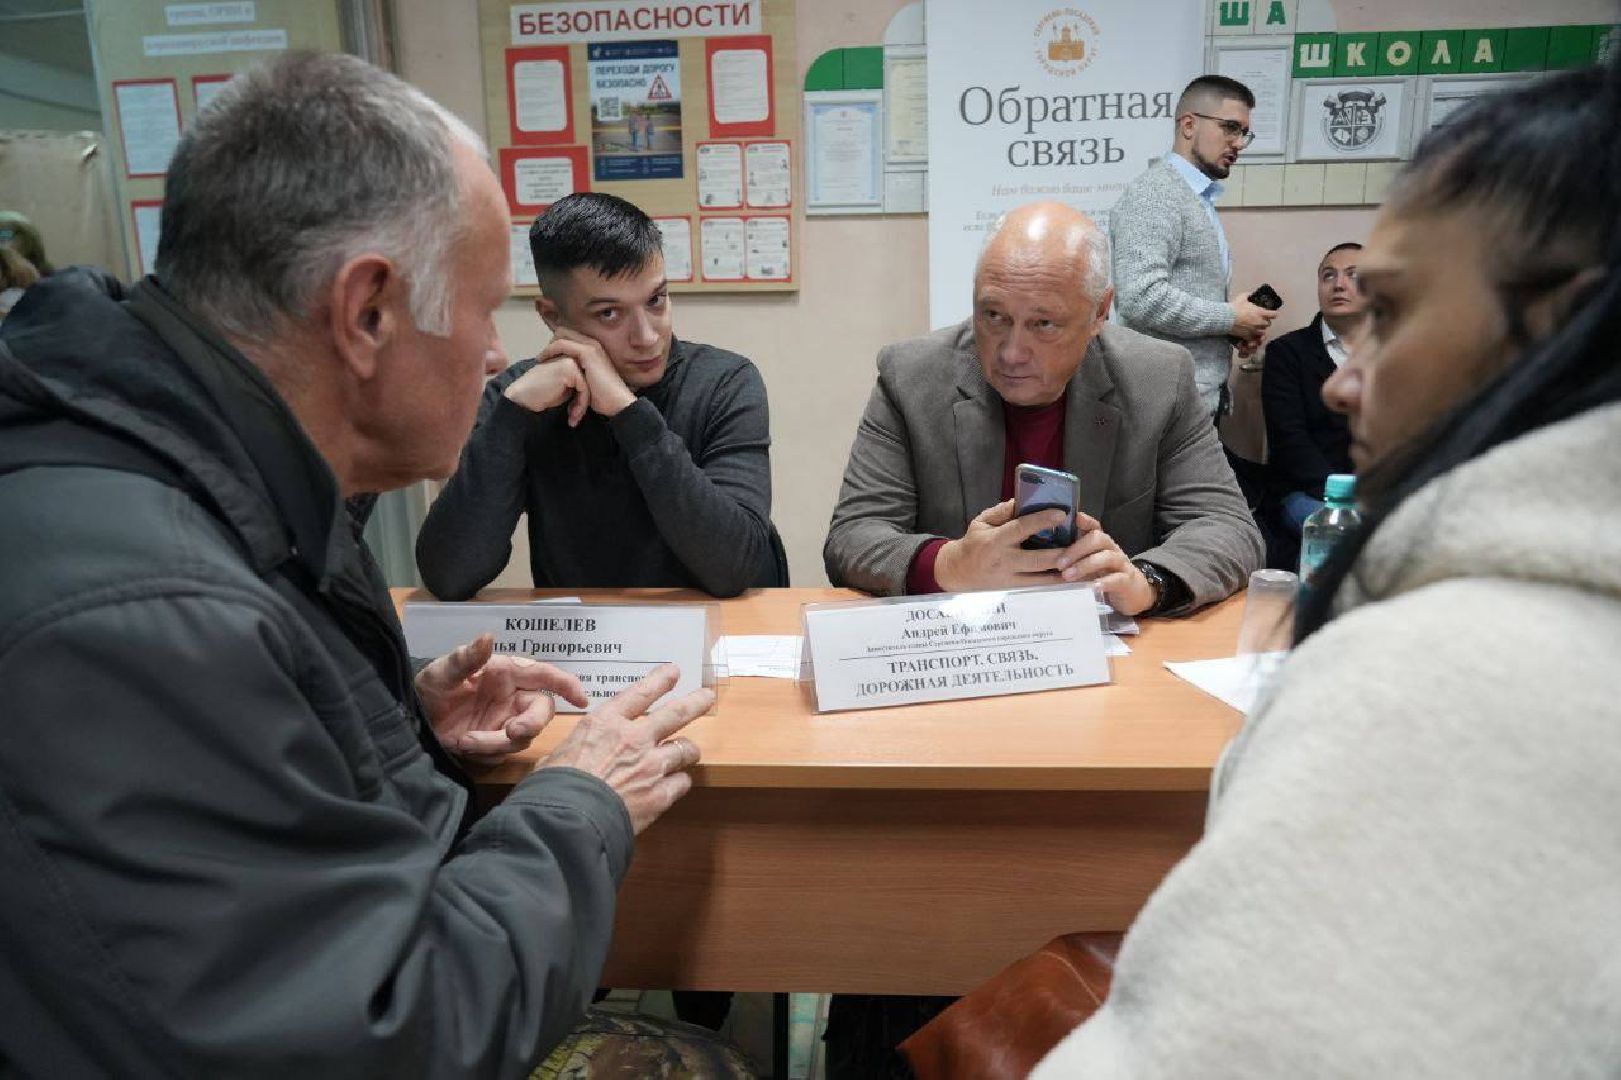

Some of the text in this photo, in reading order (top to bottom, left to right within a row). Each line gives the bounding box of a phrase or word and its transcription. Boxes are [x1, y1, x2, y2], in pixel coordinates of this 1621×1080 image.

[519, 2, 752, 36] БЕЗОПАСНОСТИ
[1300, 39, 1494, 68] ШКОЛА
[959, 84, 1174, 134] Обратная
[1008, 137, 1125, 167] связь
[505, 618, 596, 632] КОШЕЛЕВ
[902, 627, 948, 640] Андрей
[522, 638, 623, 656] Григорьевич
[596, 674, 645, 685] транспо
[856, 663, 1074, 697] ДОРОЖНАЯ ДЕЯТЕЛЬНОСТЬ
